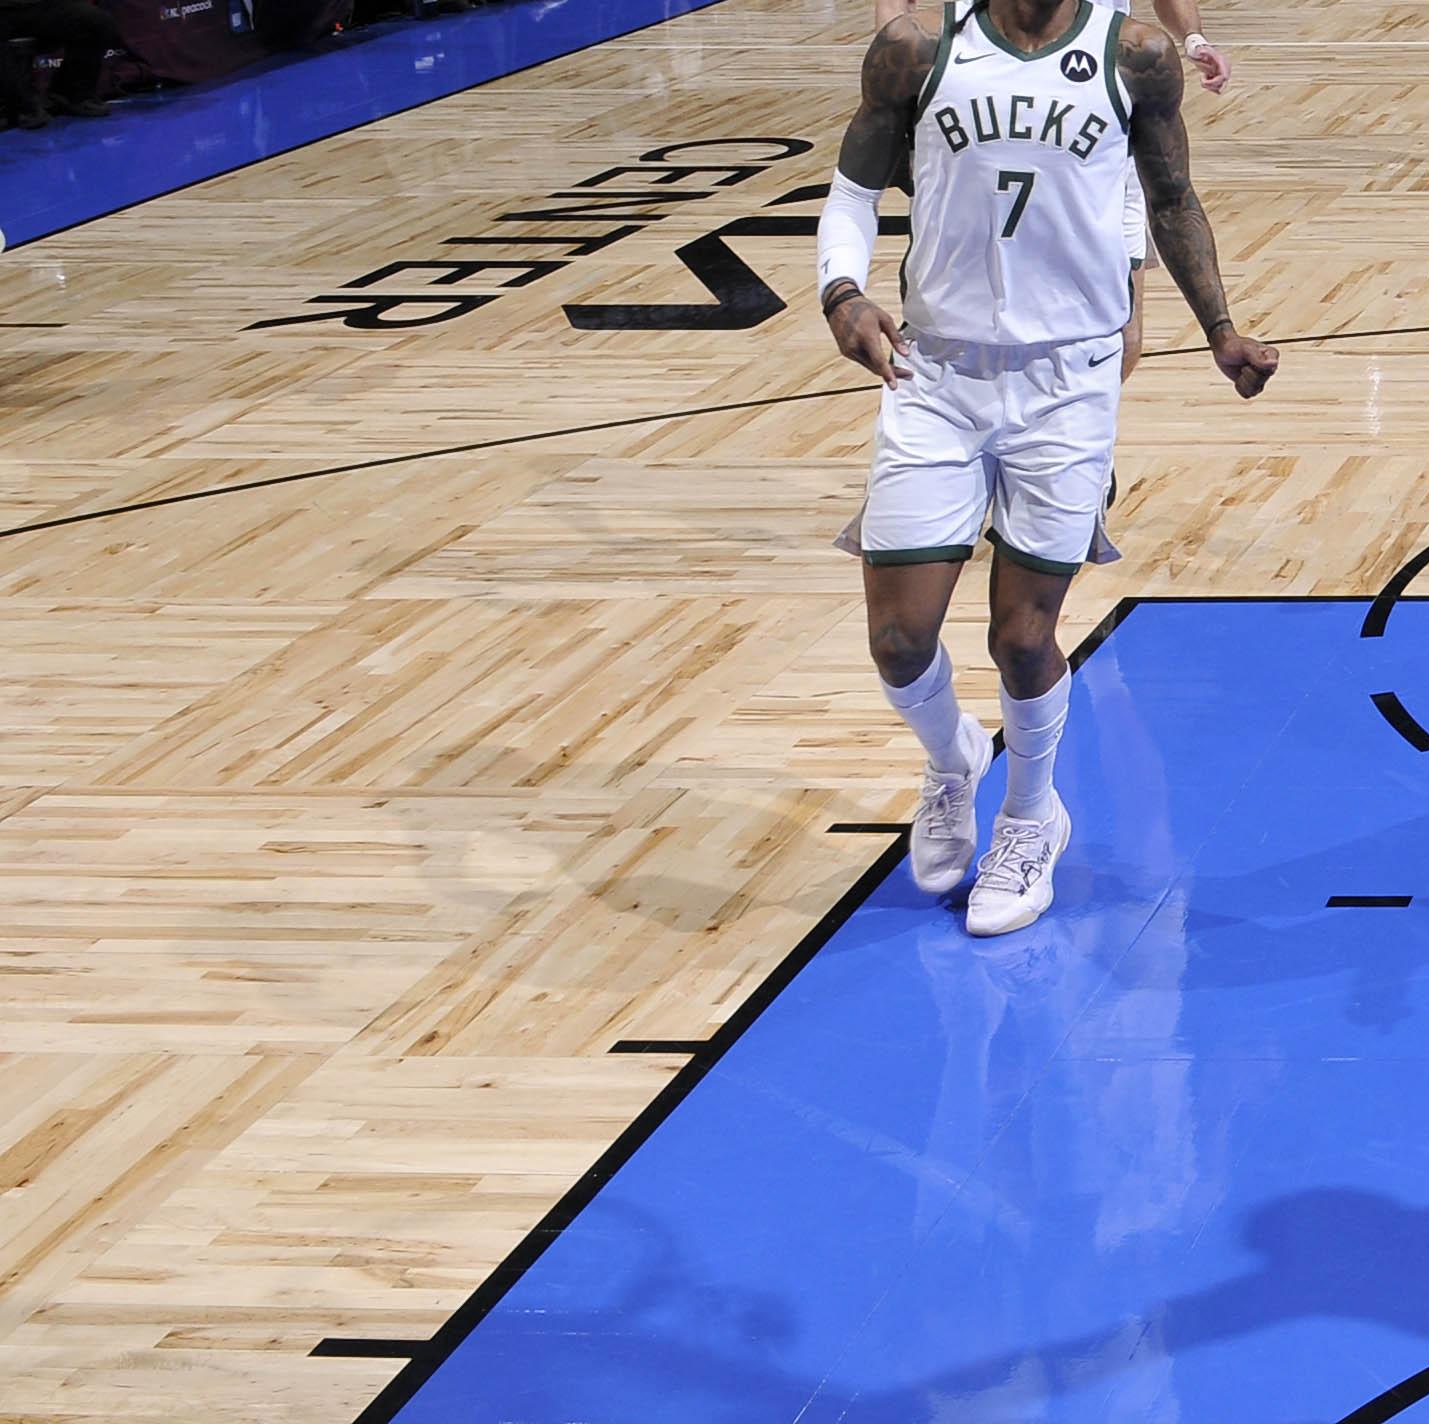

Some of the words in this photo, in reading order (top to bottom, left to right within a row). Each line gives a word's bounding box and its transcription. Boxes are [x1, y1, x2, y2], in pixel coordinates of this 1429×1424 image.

[935, 94, 1109, 160] BUCKS
[238, 137, 815, 333] CENTER
[994, 169, 1036, 240] 7
